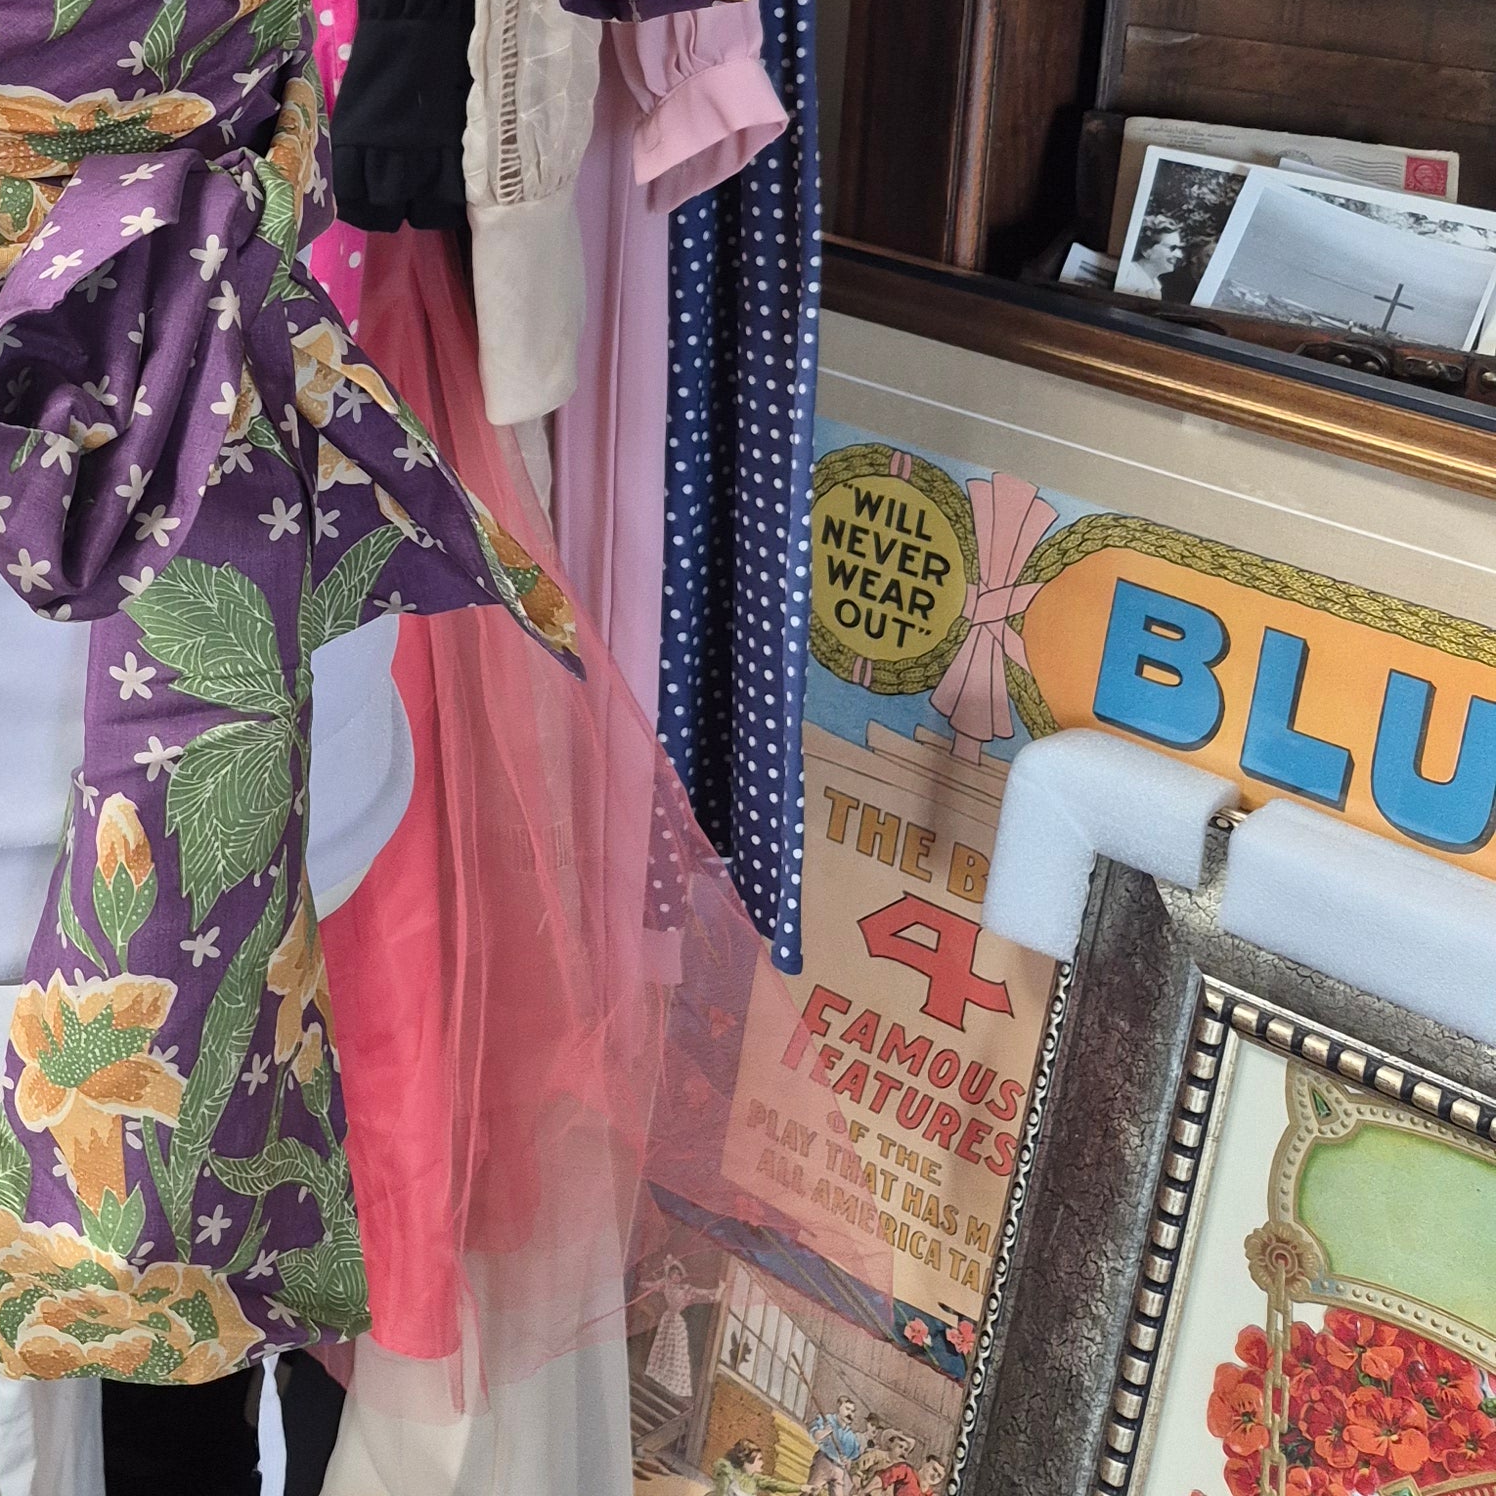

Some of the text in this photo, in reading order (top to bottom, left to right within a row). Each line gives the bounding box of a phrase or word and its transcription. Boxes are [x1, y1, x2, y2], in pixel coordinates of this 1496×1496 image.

[821, 514, 951, 587] NEVER
[827, 554, 935, 621] WEAR
[1092, 577, 1496, 855] BLU
[823, 786, 937, 884] THE
[857, 890, 1015, 1033] 4
[780, 983, 1026, 1122] FAMOUS
[747, 1098, 818, 1158] PLAY
[825, 1139, 899, 1202] THAT
[901, 1181, 960, 1236] HAS
[826, 1110, 943, 1187] OF THE
[756, 1149, 806, 1198] ALL
[810, 1178, 942, 1272] AMERICA
